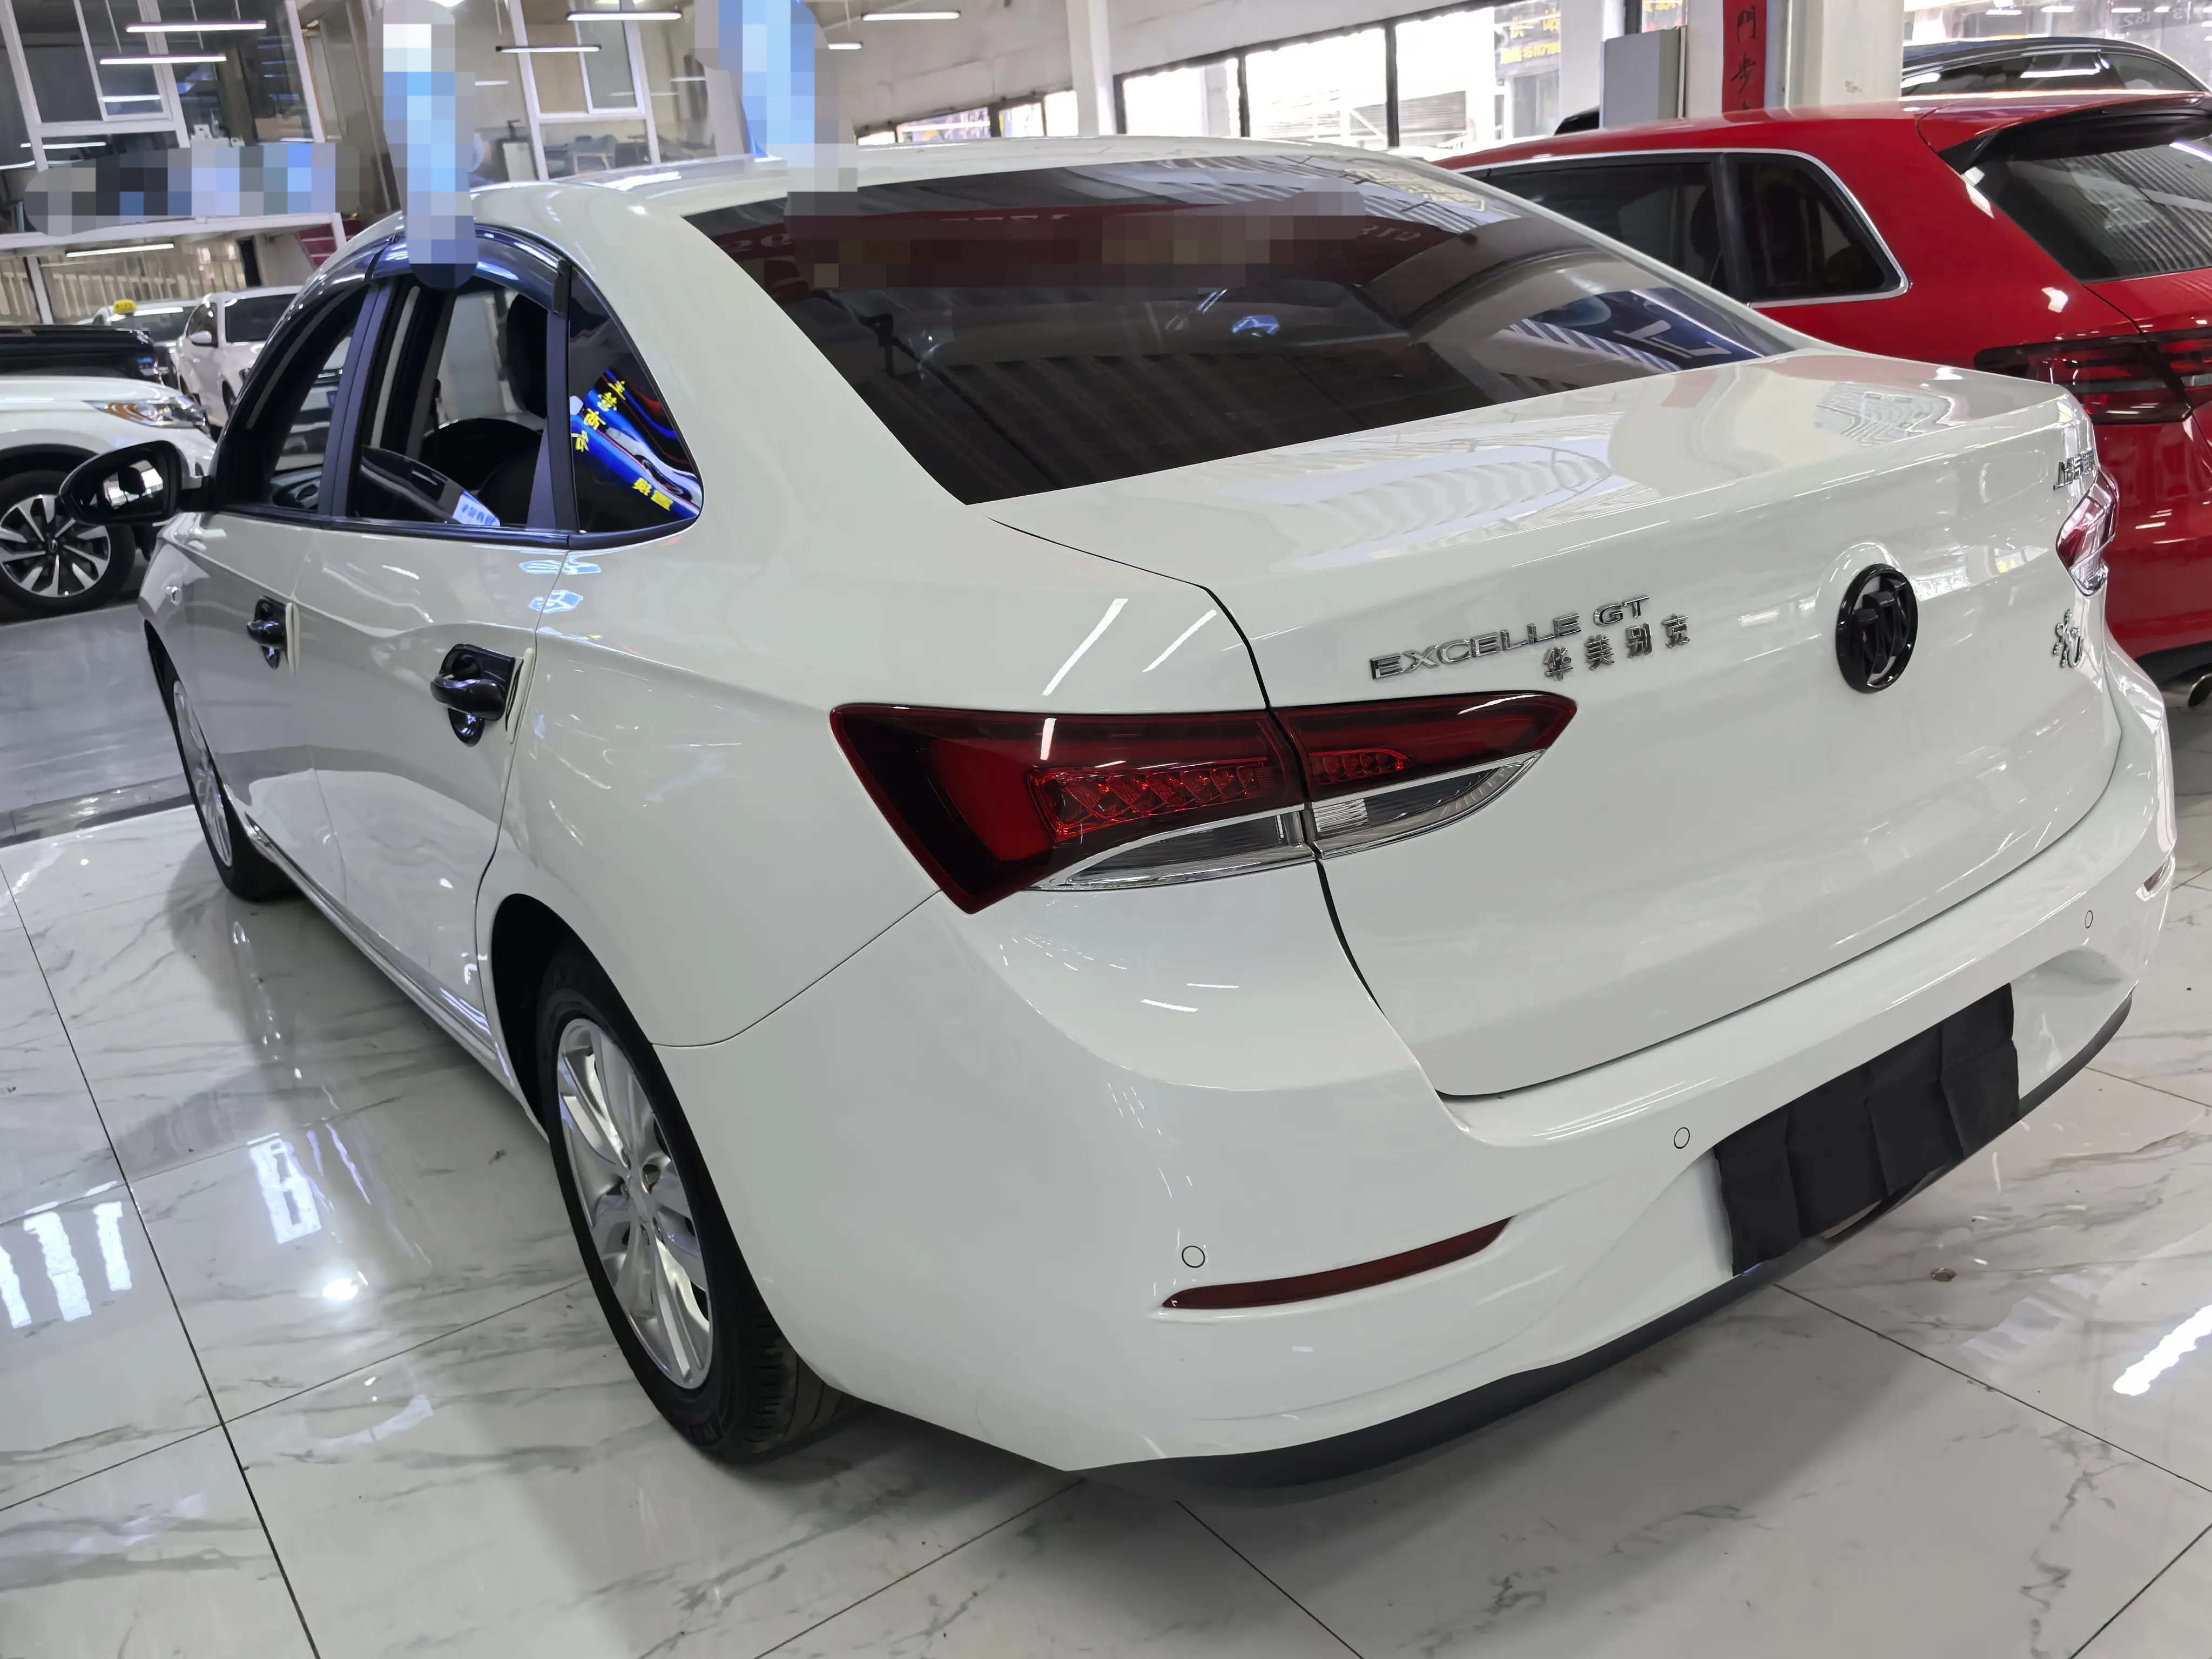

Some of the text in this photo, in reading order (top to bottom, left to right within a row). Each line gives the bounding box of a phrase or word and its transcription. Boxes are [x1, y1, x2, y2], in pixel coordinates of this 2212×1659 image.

[1370, 594, 1650, 680] EXCELLE GT
[1542, 612, 1691, 681] 华美别克
